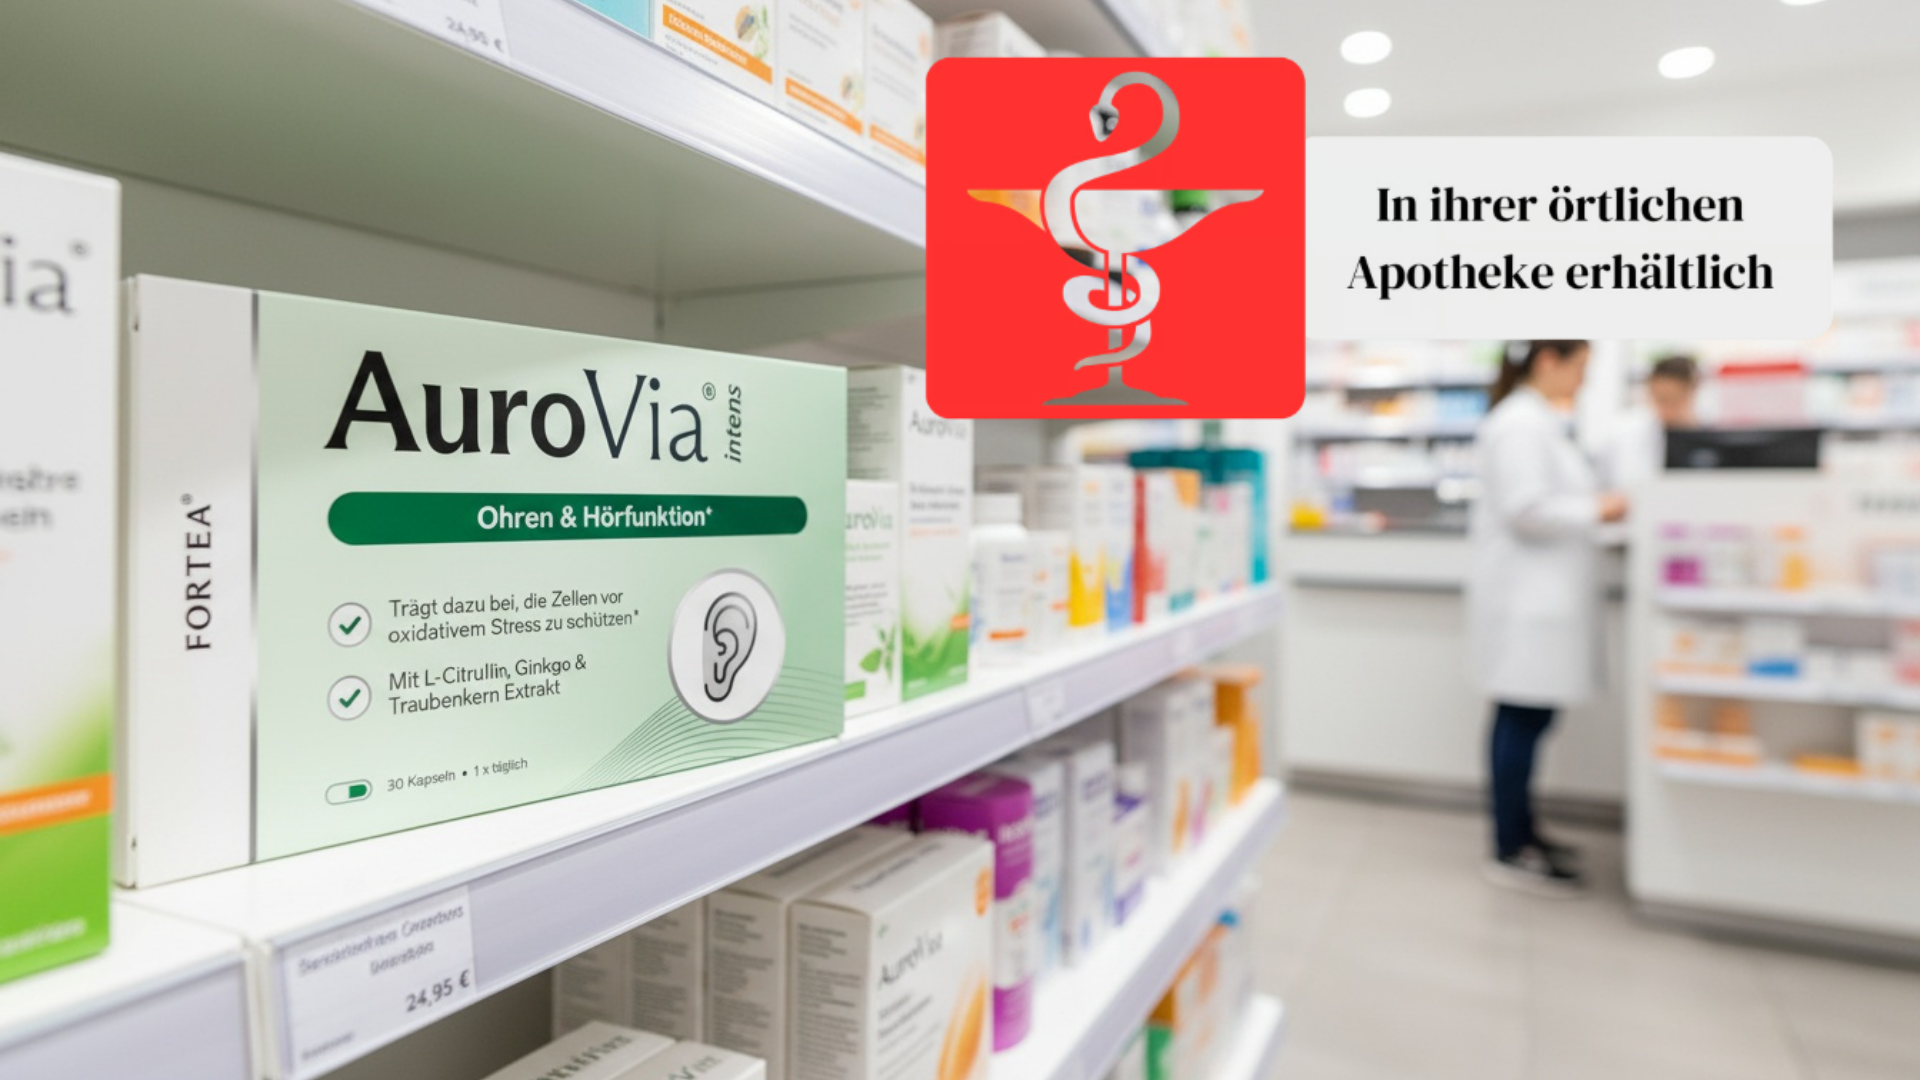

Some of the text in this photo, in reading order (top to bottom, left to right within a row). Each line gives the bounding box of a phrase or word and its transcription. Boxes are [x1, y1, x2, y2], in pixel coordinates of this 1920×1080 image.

[724, 384, 742, 463] intens
[477, 505, 554, 529] Ohren
[560, 506, 578, 528] &
[389, 590, 623, 619] Trägt dazu bei, die Zellen vor
[388, 621, 486, 643] oxidativem
[491, 618, 541, 635] Stress
[545, 616, 563, 631] zu
[389, 653, 587, 691] Mit L-Citrullin, Ginkgo &
[389, 679, 561, 715] Traubenkern Extrakt
[387, 778, 404, 792] 30
[407, 770, 456, 788] Kapseln
[474, 765, 479, 777] 1
[482, 766, 490, 776] x
[405, 969, 470, 1013] 24,95 €
